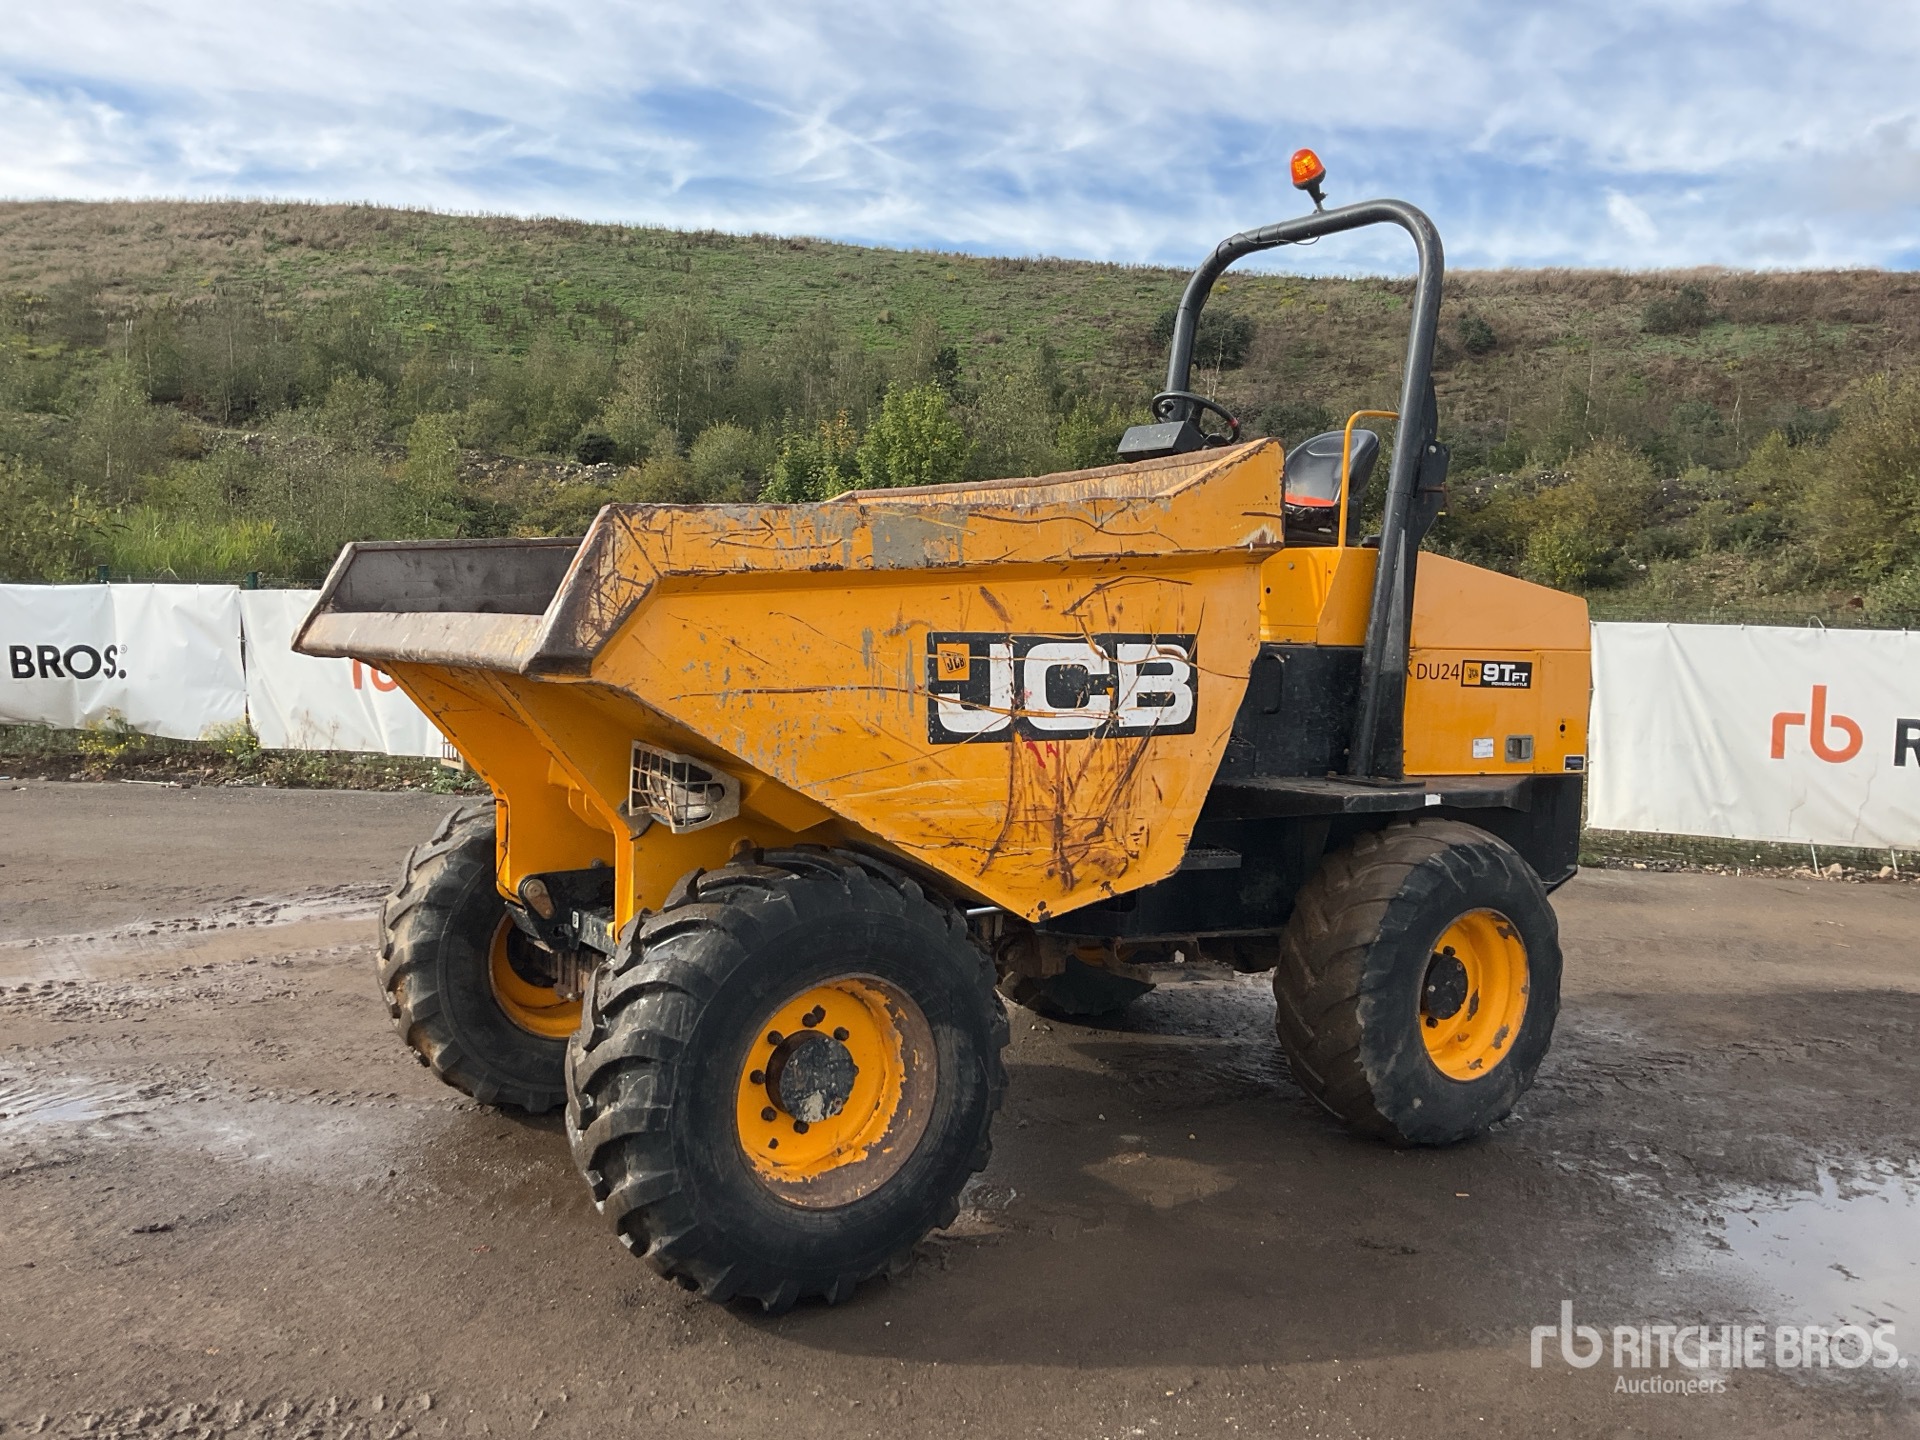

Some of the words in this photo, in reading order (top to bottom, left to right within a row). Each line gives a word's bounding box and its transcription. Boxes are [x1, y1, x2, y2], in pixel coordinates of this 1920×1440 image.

[9, 644, 127, 680] BROS.
[938, 643, 1193, 733] JCB
[1417, 663, 1460, 680] DU24
[1771, 685, 1864, 764] rb
